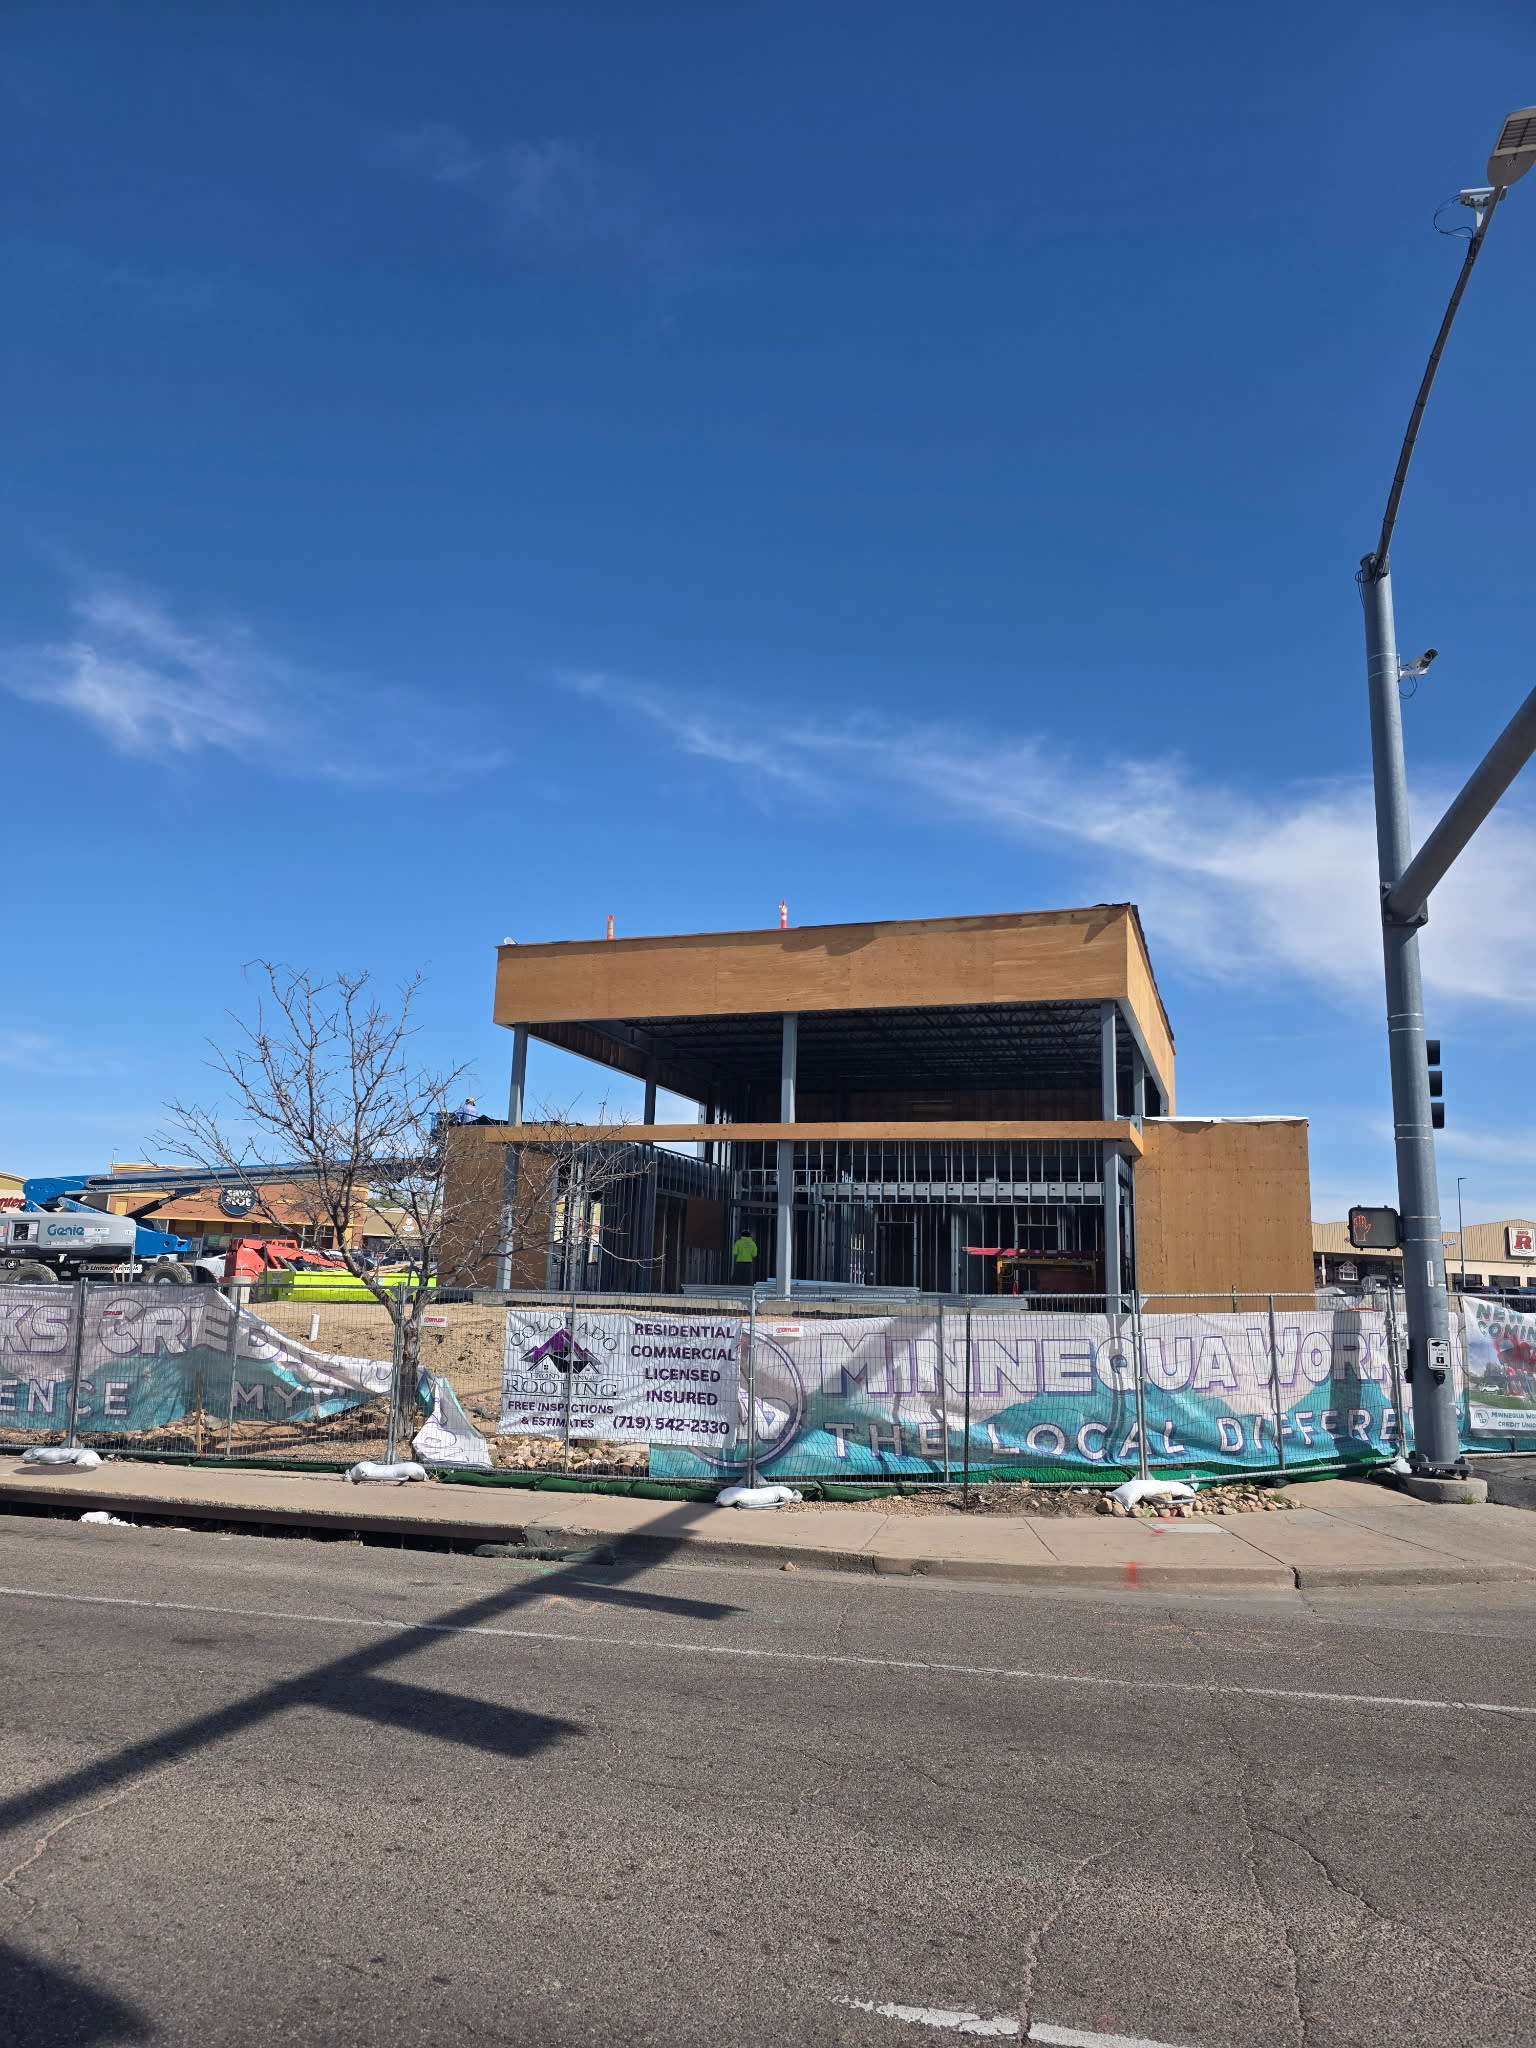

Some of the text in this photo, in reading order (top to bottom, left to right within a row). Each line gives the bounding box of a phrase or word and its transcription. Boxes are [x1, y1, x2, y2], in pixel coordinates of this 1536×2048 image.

[47, 1224, 84, 1237] Genie
[1514, 1235, 1532, 1249] R
[634, 1323, 735, 1339] RESIDENTIAL
[630, 1345, 736, 1361] COMMERCIAL
[819, 1331, 1238, 1397] MINNEQUA
[645, 1367, 721, 1382] LICENSED
[508, 1400, 535, 1412] FREE
[646, 1390, 718, 1406] INSURED
[521, 1416, 529, 1426] &
[613, 1415, 730, 1436] (719) 542-2330
[823, 1421, 945, 1459] THE
[986, 1419, 1189, 1462] LOCAL
